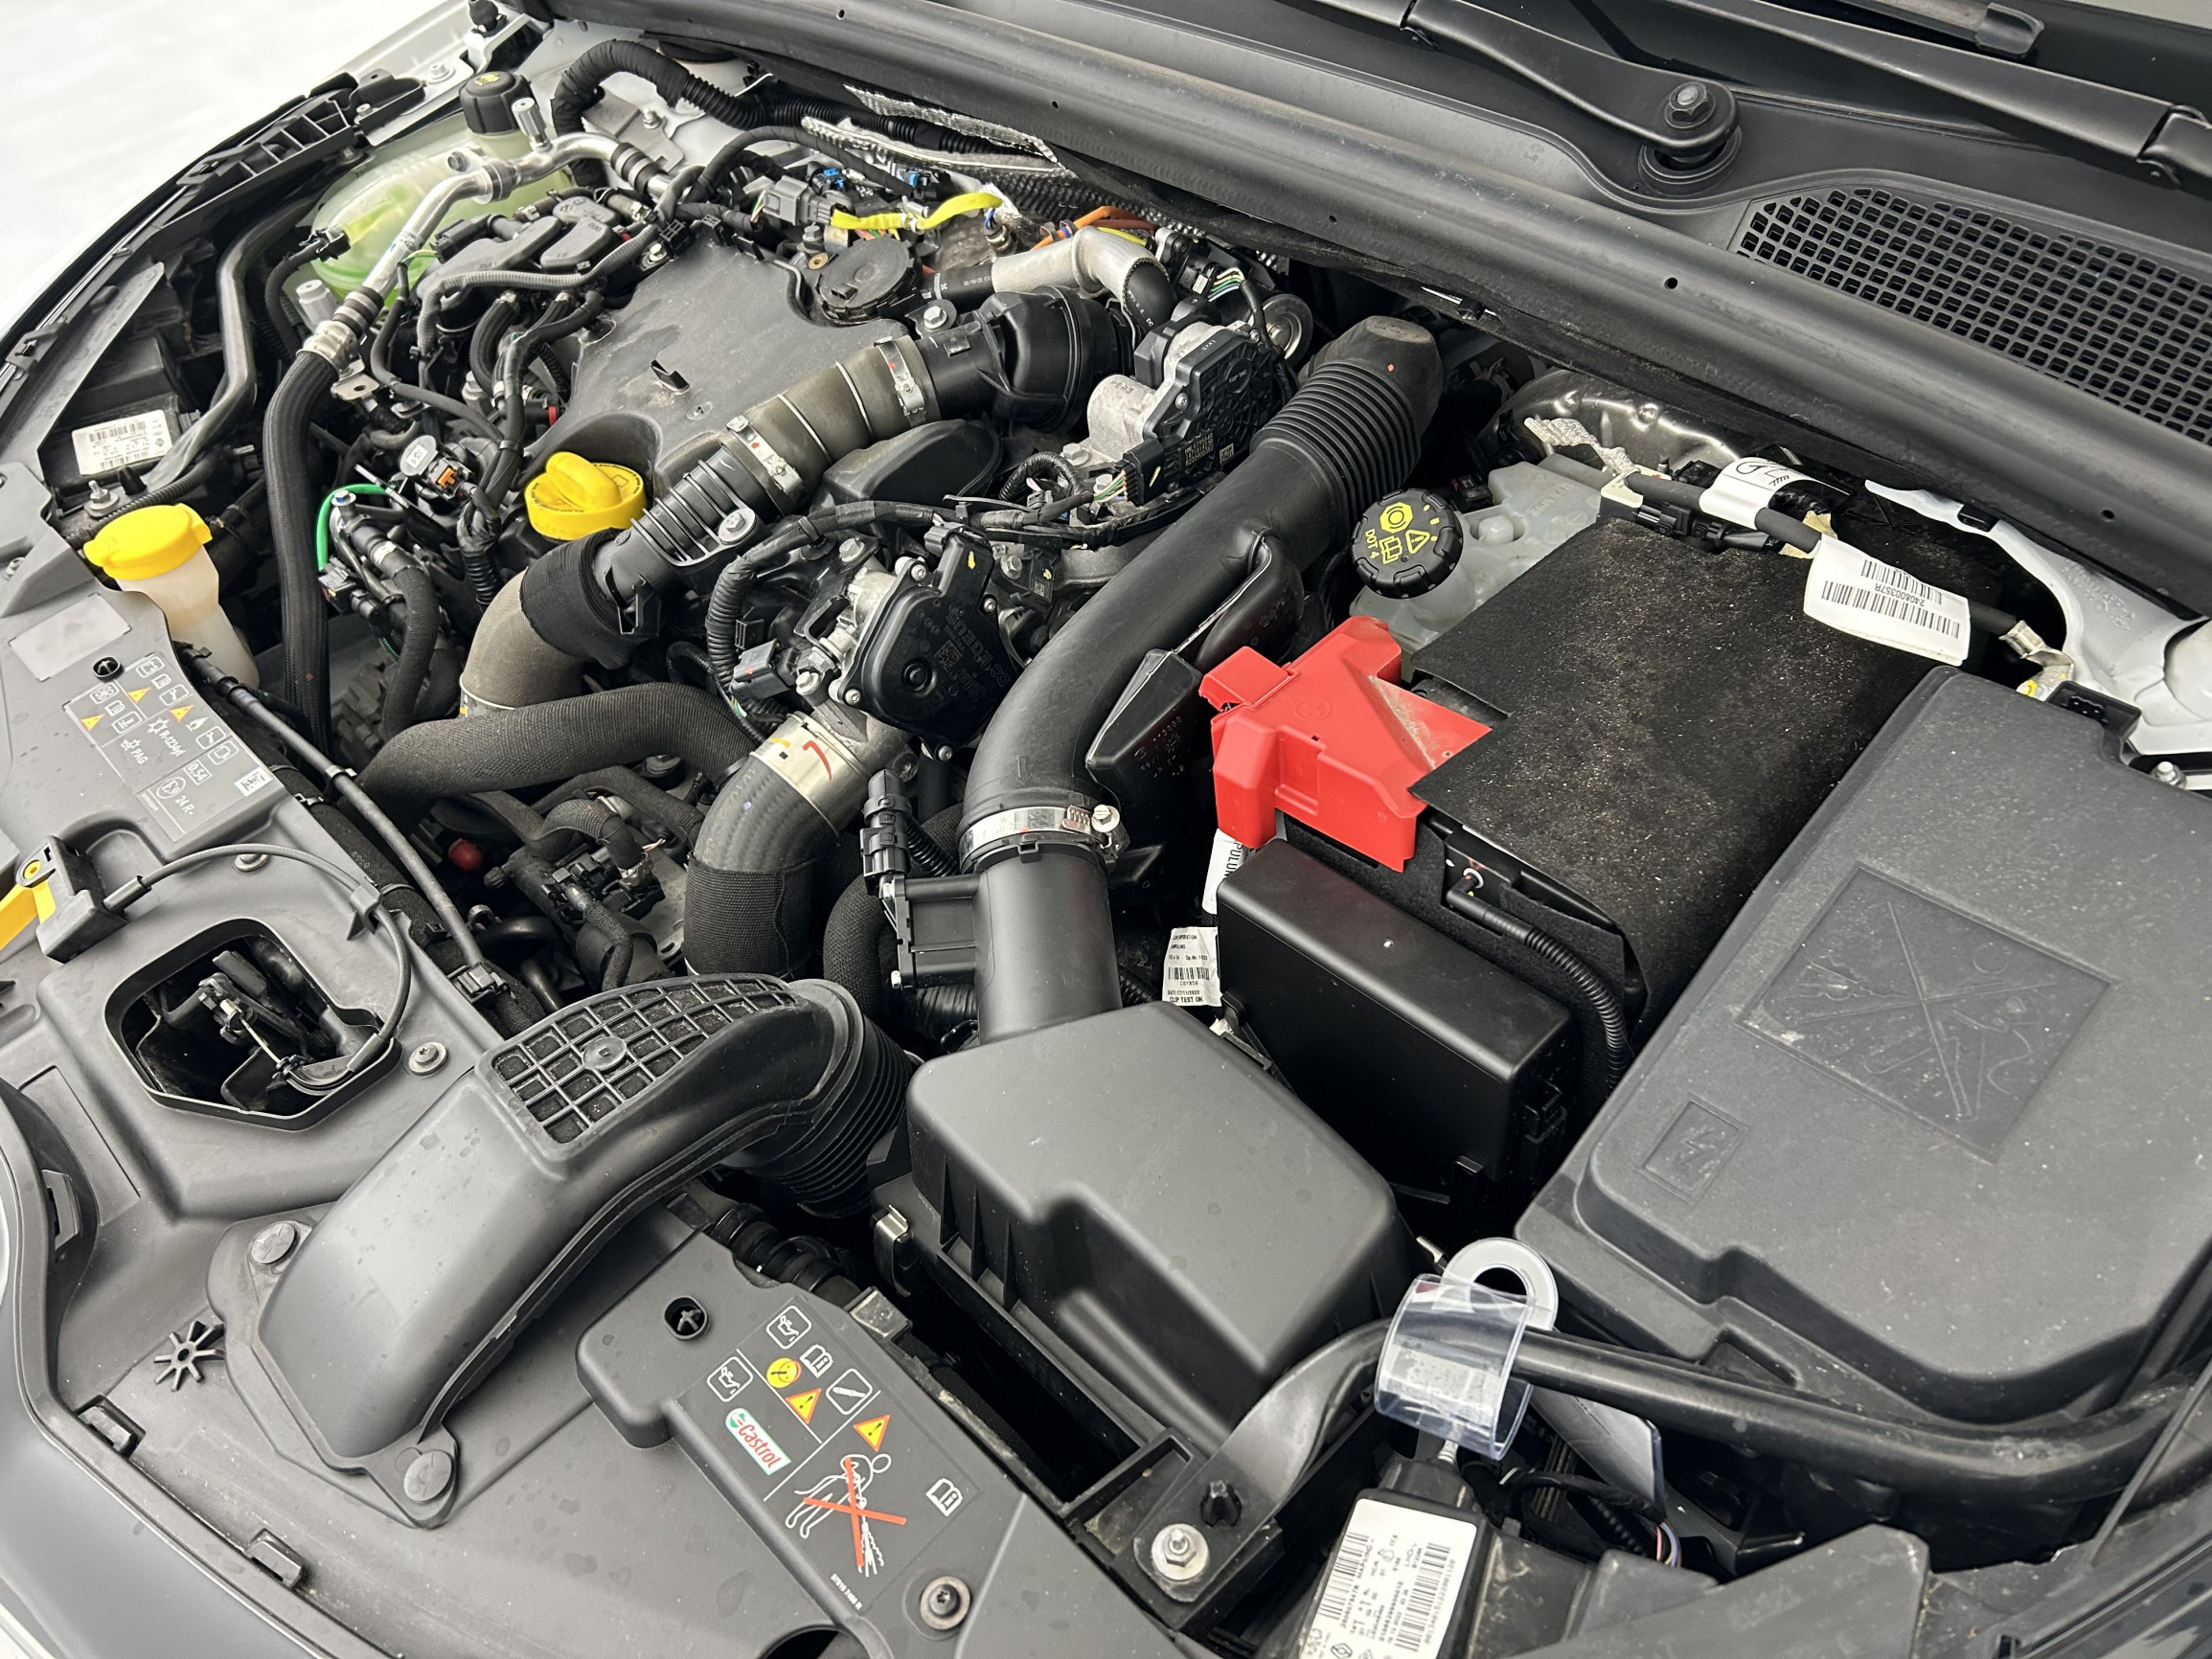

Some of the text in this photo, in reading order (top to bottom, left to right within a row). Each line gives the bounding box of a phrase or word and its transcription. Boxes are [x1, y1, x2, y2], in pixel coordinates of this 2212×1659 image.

[1365, 529, 1380, 559] DOT 4
[1875, 582, 1926, 607] 240800357R
[130, 747, 149, 764] PAG
[158, 729, 186, 757] R-1234yf
[738, 1424, 783, 1468] Castrol
